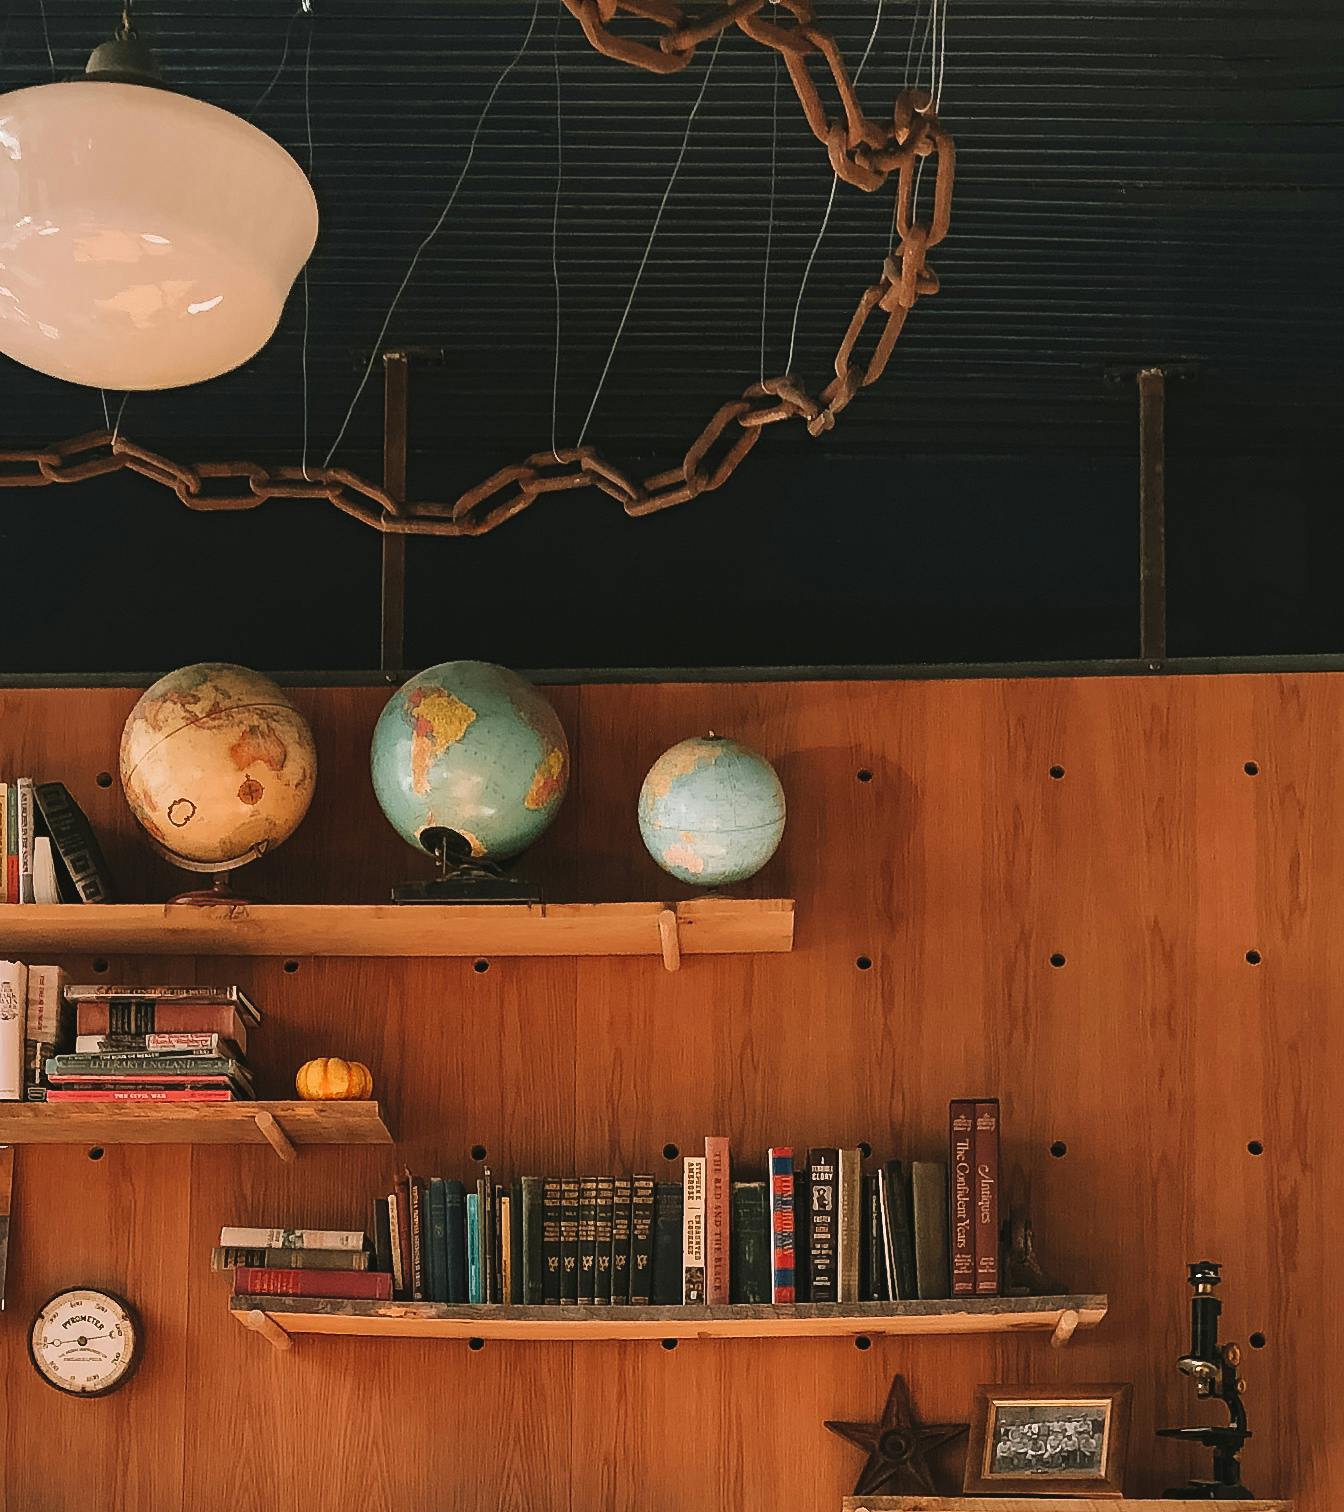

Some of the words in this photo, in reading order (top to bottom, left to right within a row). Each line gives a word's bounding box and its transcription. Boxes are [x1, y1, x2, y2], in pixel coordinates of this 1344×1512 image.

[90, 1059, 141, 1069] LITERARY
[143, 1059, 196, 1068] ENGLAND
[956, 1139, 970, 1161] The
[714, 1152, 722, 1174] THE
[714, 1177, 722, 1200] RED
[782, 1176, 794, 1202] TOM
[812, 1173, 833, 1181] GLORY
[956, 1163, 970, 1218] Confident
[978, 1165, 994, 1224] Antiques
[714, 1204, 722, 1227] AND
[714, 1228, 722, 1253] THE
[782, 1204, 794, 1256] BROKAW
[956, 1220, 970, 1248] Years
[714, 1257, 722, 1292] BLACK
[62, 1315, 105, 1331] PYROMETER
